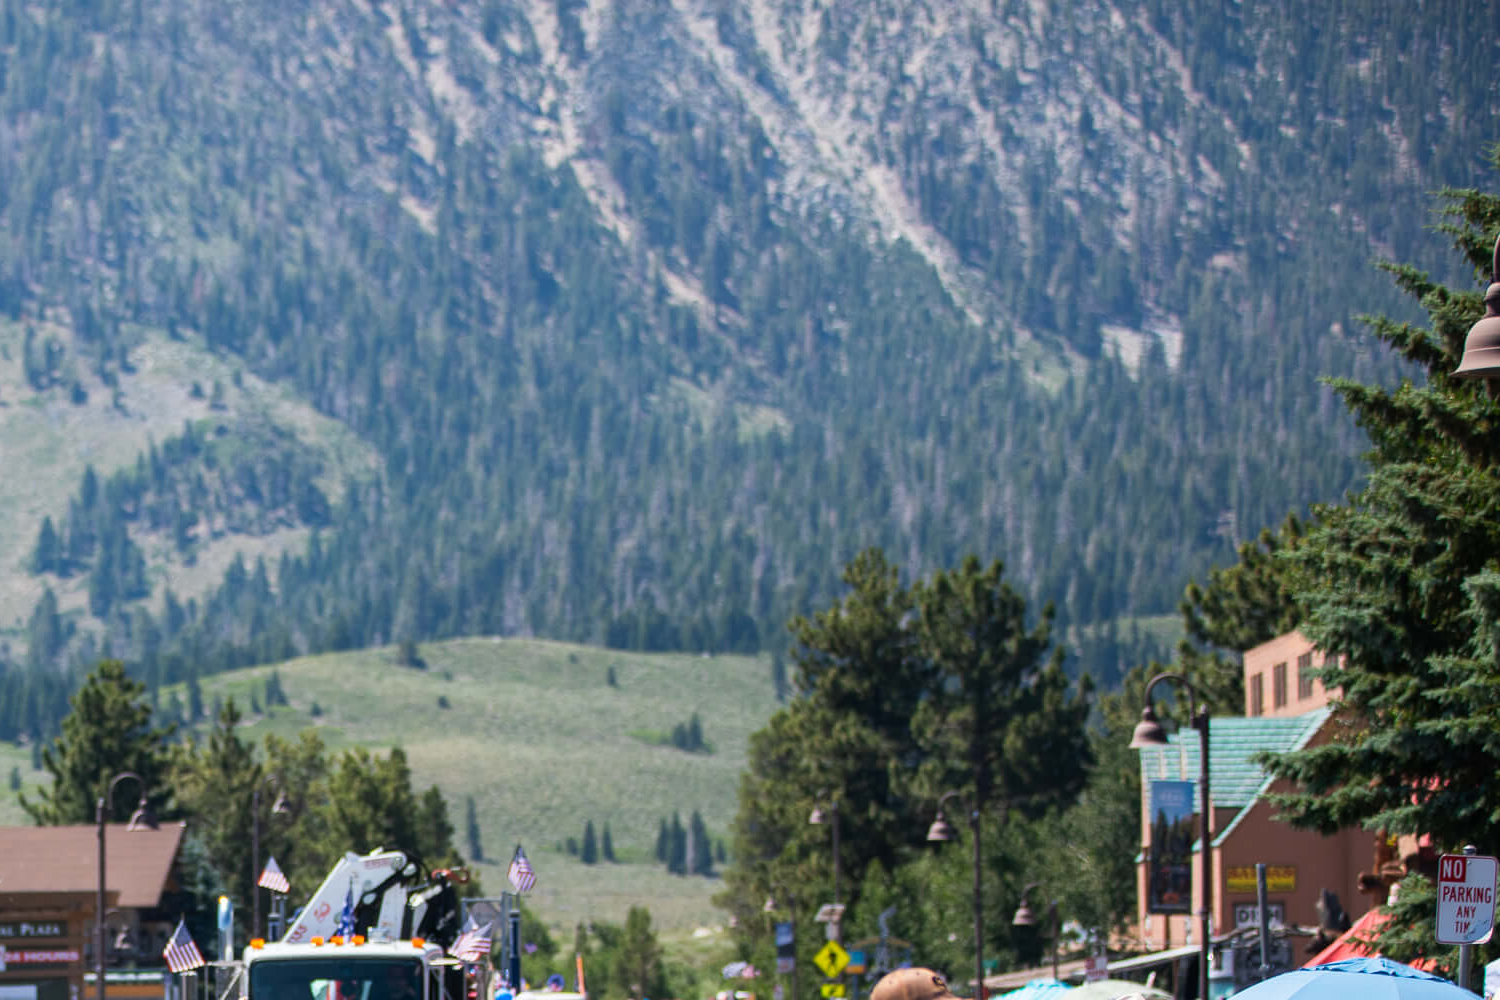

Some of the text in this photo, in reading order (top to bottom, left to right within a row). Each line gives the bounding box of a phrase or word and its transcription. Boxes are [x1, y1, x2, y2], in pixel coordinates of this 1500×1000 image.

[1442, 859, 1463, 880] NO
[1442, 886, 1492, 904] PARKING
[1455, 904, 1477, 919] ANY
[19, 922, 61, 936] PLAZA
[23, 951, 79, 963] HOURS
